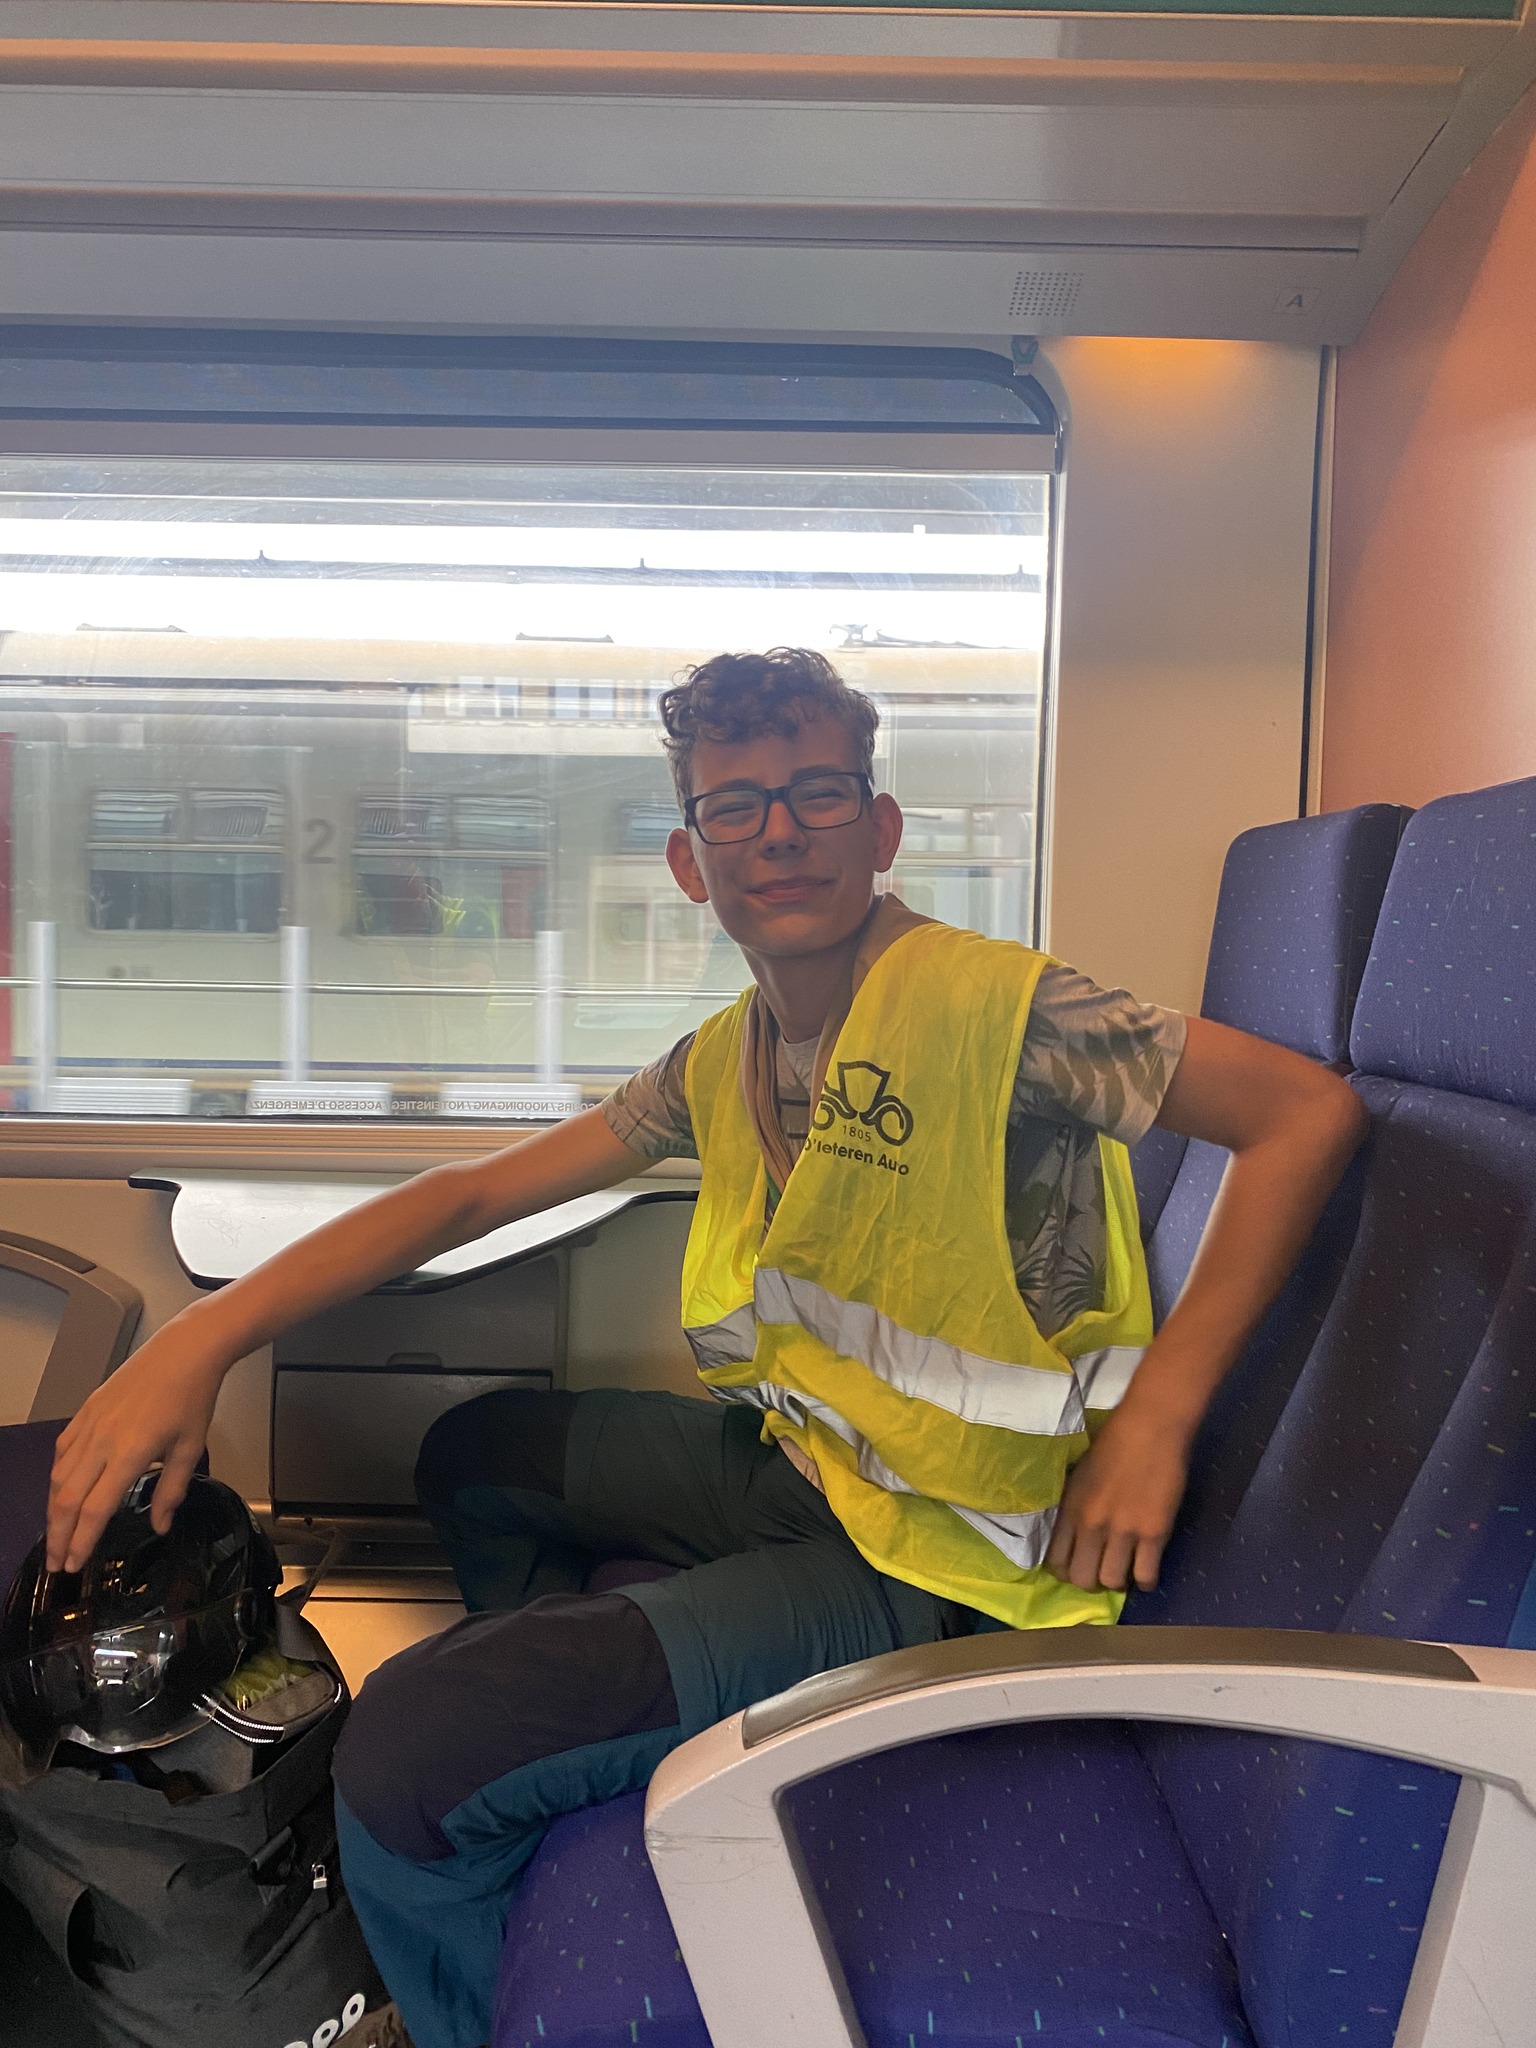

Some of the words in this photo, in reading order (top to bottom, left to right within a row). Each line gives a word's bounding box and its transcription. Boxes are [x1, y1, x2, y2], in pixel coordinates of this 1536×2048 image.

[1286, 294, 1303, 308] A
[303, 818, 336, 865] 2
[842, 1124, 872, 1142] 1805
[877, 1153, 910, 1175] Auo
